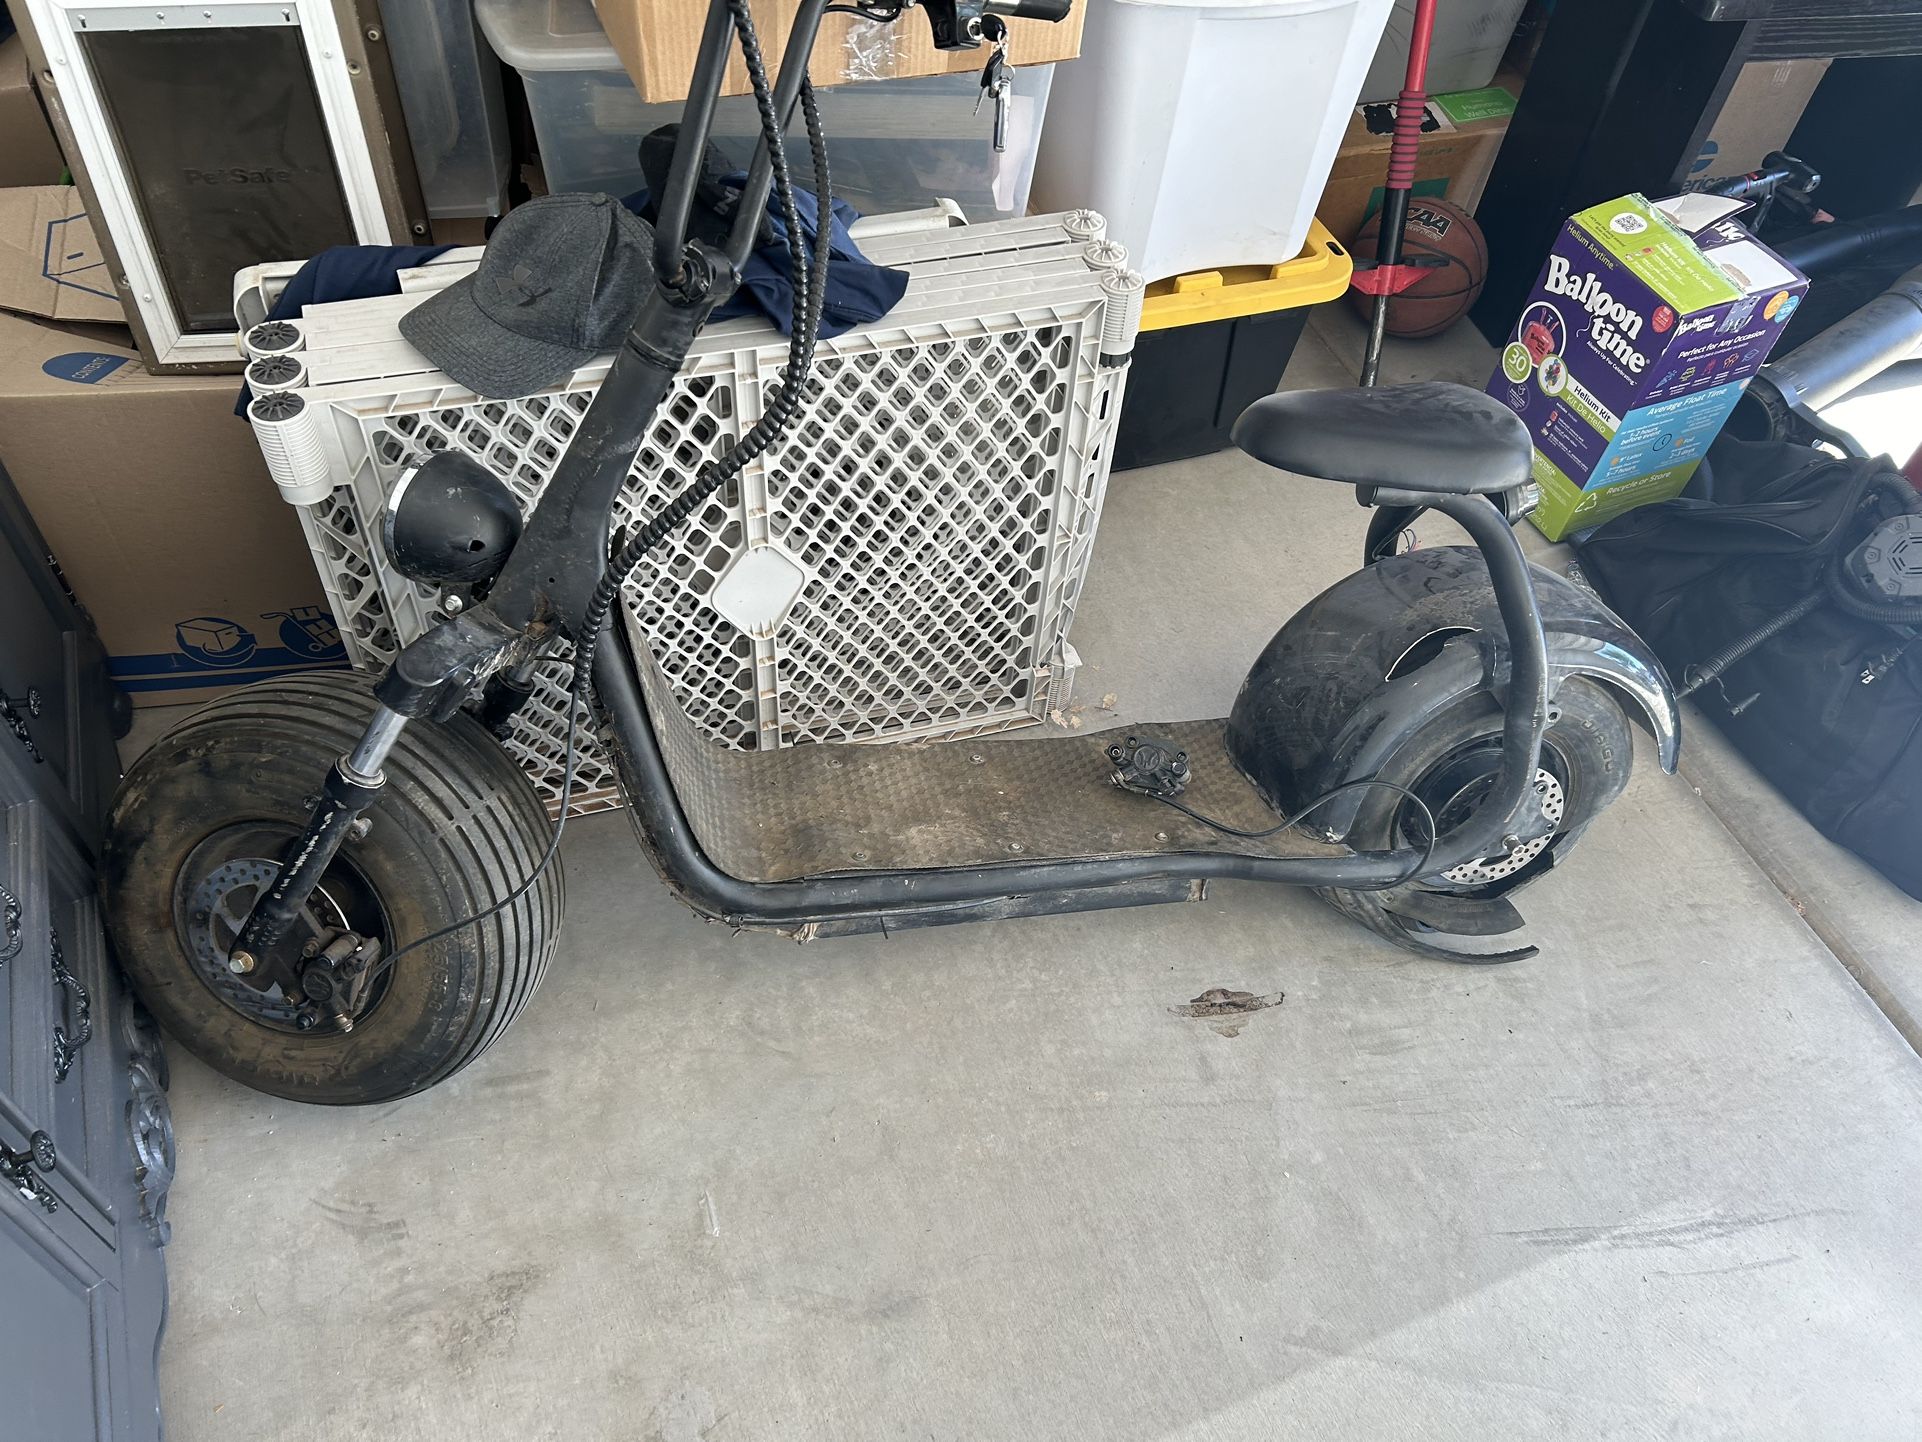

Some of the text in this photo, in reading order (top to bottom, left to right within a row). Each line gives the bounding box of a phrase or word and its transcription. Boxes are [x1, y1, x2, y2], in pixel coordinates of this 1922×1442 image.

[1567, 223, 1589, 247] Helium
[1544, 254, 1643, 340] Balloon
[1591, 317, 1645, 373] time
[1678, 329, 1767, 359] Perfect for Any Occasion
[1508, 347, 1527, 372] 30
[1566, 393, 1577, 407] Kit
[1577, 404, 1588, 417] De
[1587, 414, 1606, 433] Helio
[1573, 385, 1611, 423] Helium Kit
[1646, 401, 1684, 417] Average
[1682, 393, 1706, 407] Float
[1707, 387, 1728, 400] Time
[1606, 480, 1638, 495] Recycle
[1649, 471, 1672, 482] Store
